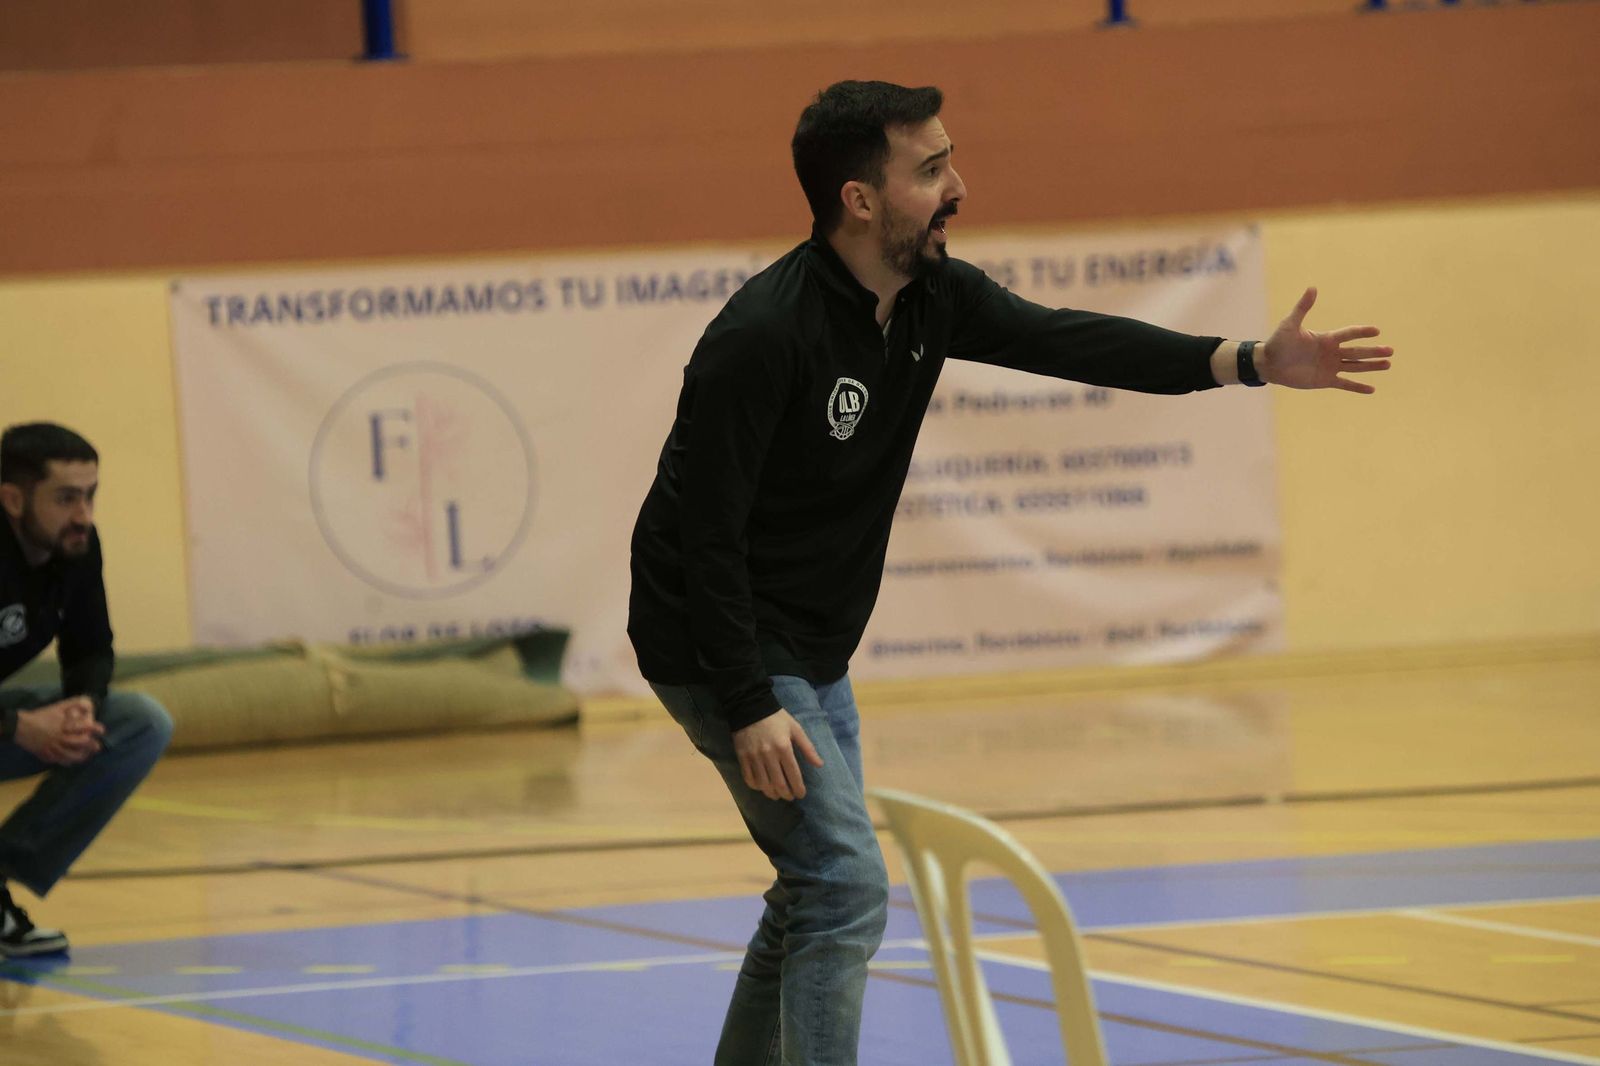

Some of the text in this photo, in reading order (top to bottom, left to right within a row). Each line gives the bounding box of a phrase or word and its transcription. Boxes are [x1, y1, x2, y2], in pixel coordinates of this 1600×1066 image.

[1030, 254, 1076, 289] TU
[208, 276, 546, 328] TRANSFORMAMOS
[559, 274, 605, 310] TU
[839, 391, 860, 414] ULB
[368, 408, 413, 482] F
